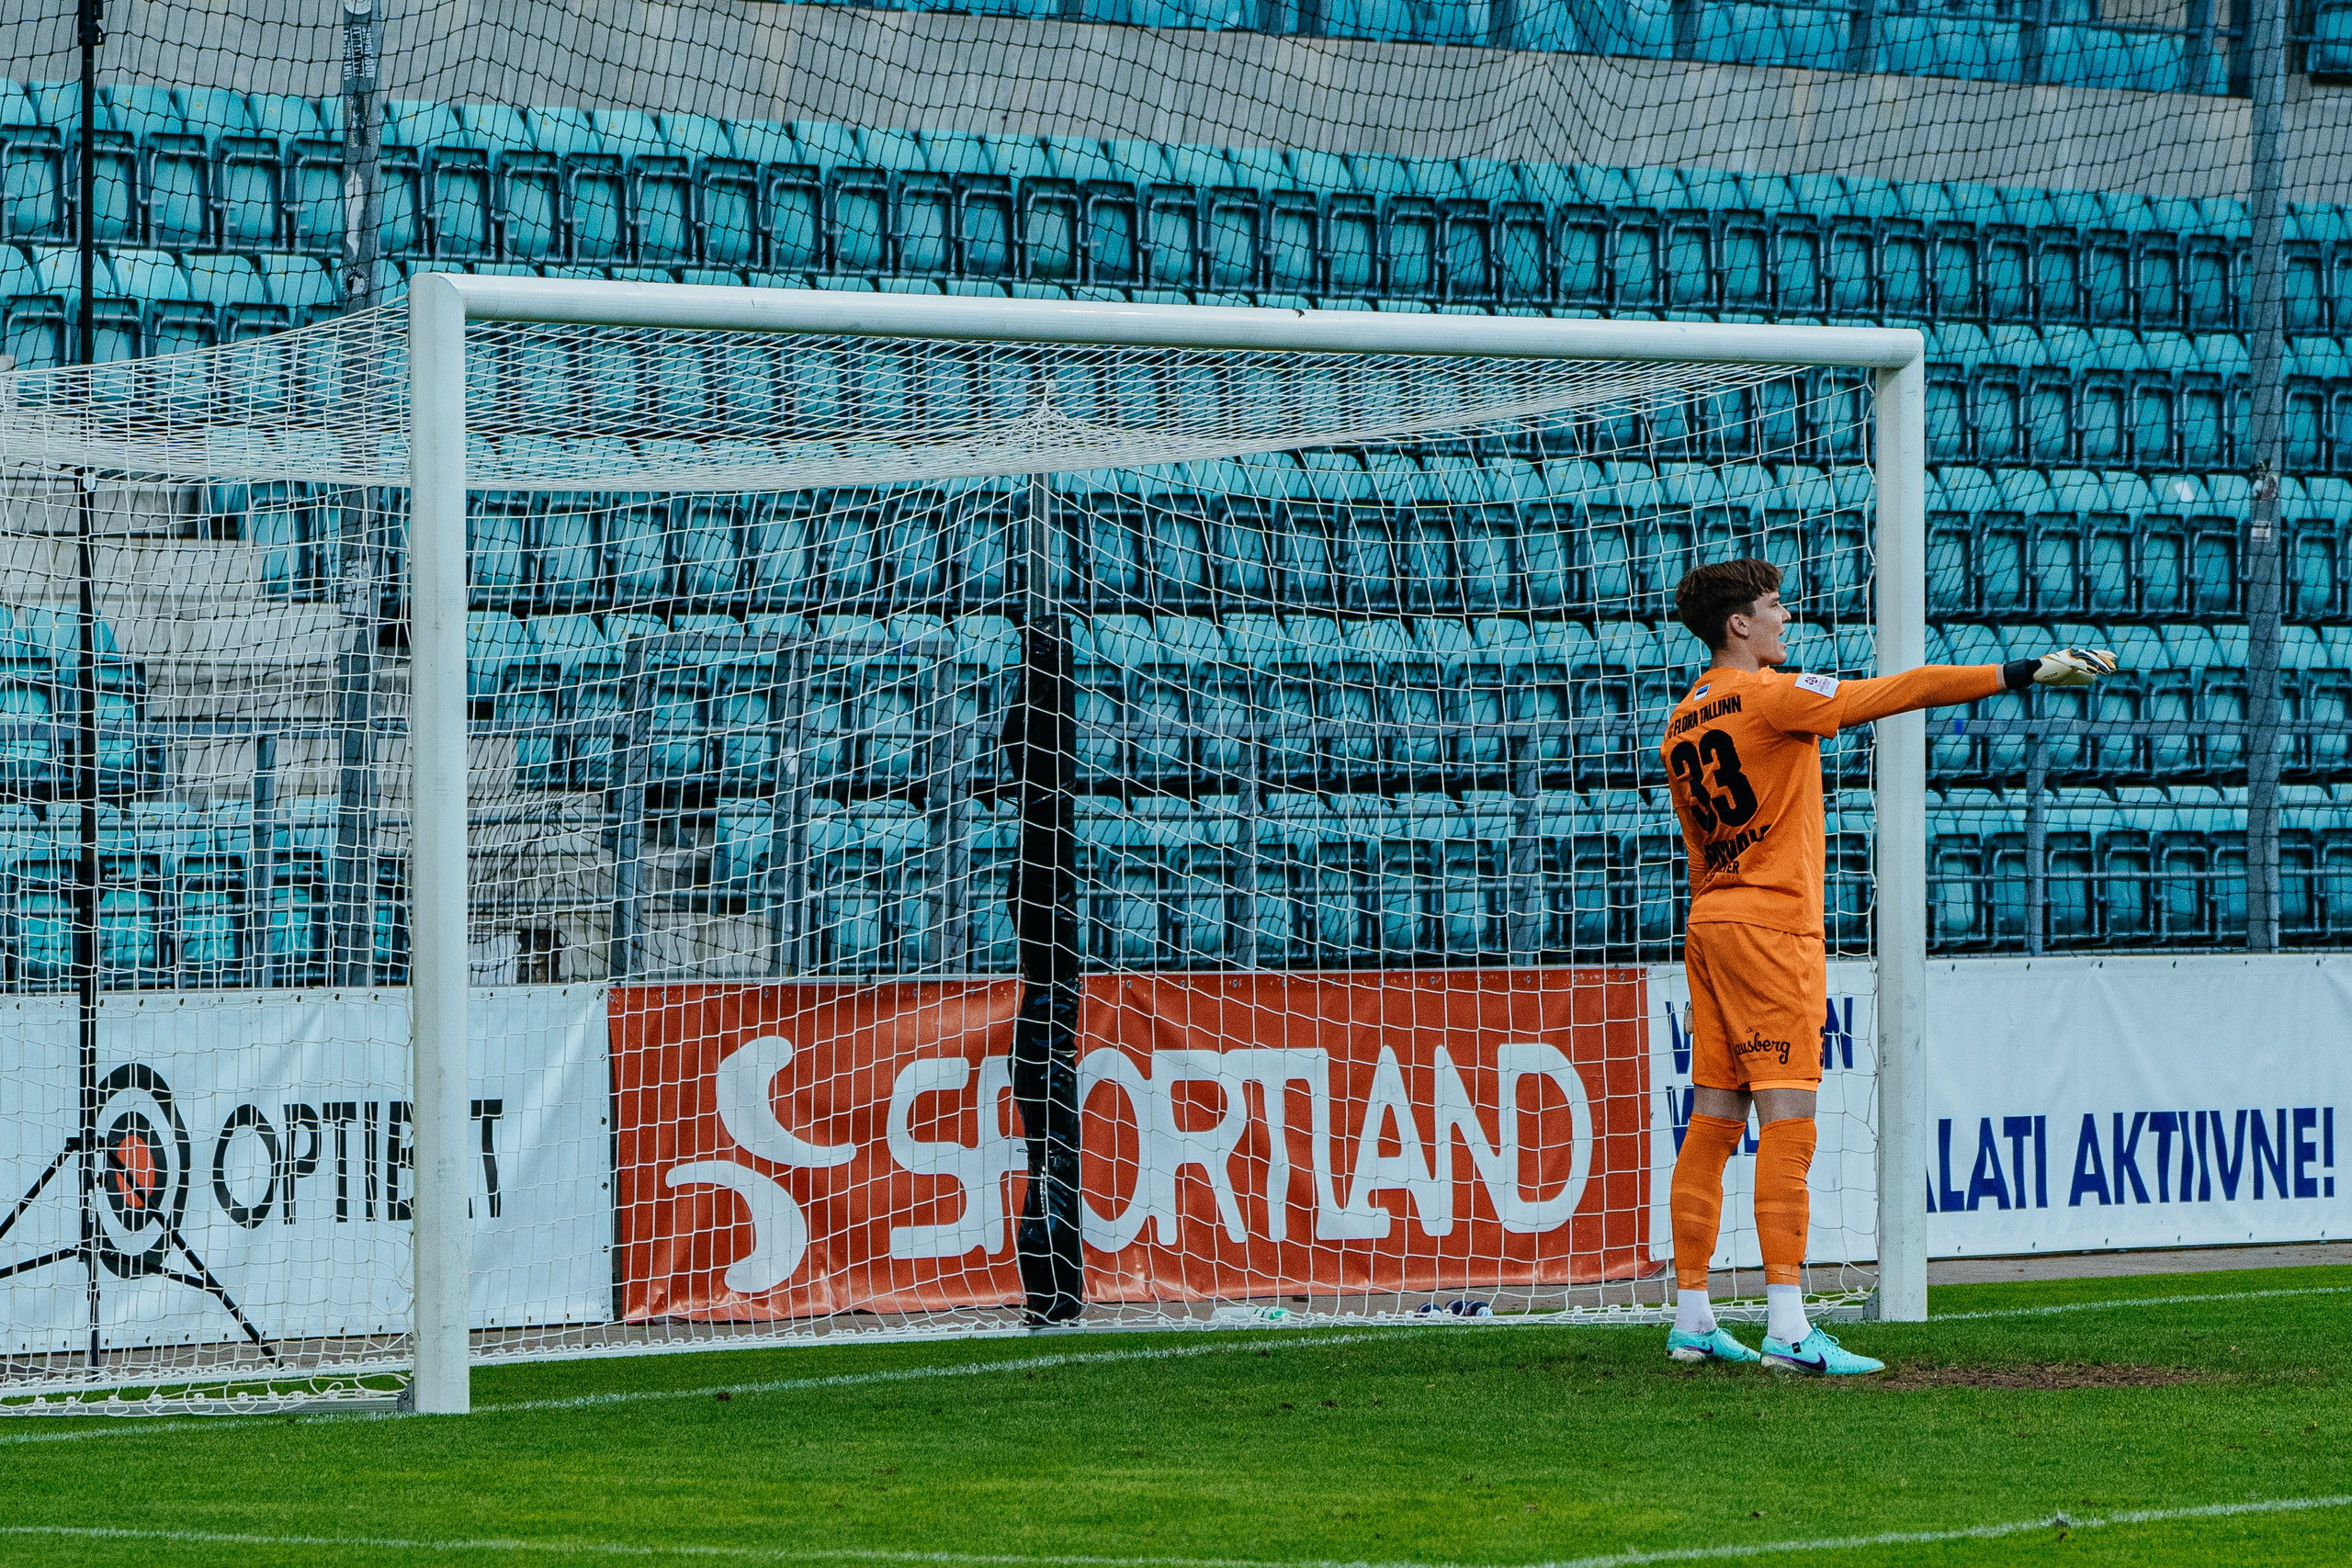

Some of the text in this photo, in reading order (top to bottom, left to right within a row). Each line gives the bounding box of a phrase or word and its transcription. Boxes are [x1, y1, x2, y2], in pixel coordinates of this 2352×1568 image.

[1674, 711, 1699, 738] FLORA
[1700, 694, 1742, 725] TALLINN
[1670, 728, 1758, 836] 33
[212, 1099, 503, 1230] OPTIBT
[1927, 1106, 2335, 1213] LATI AKTIIVNE!
